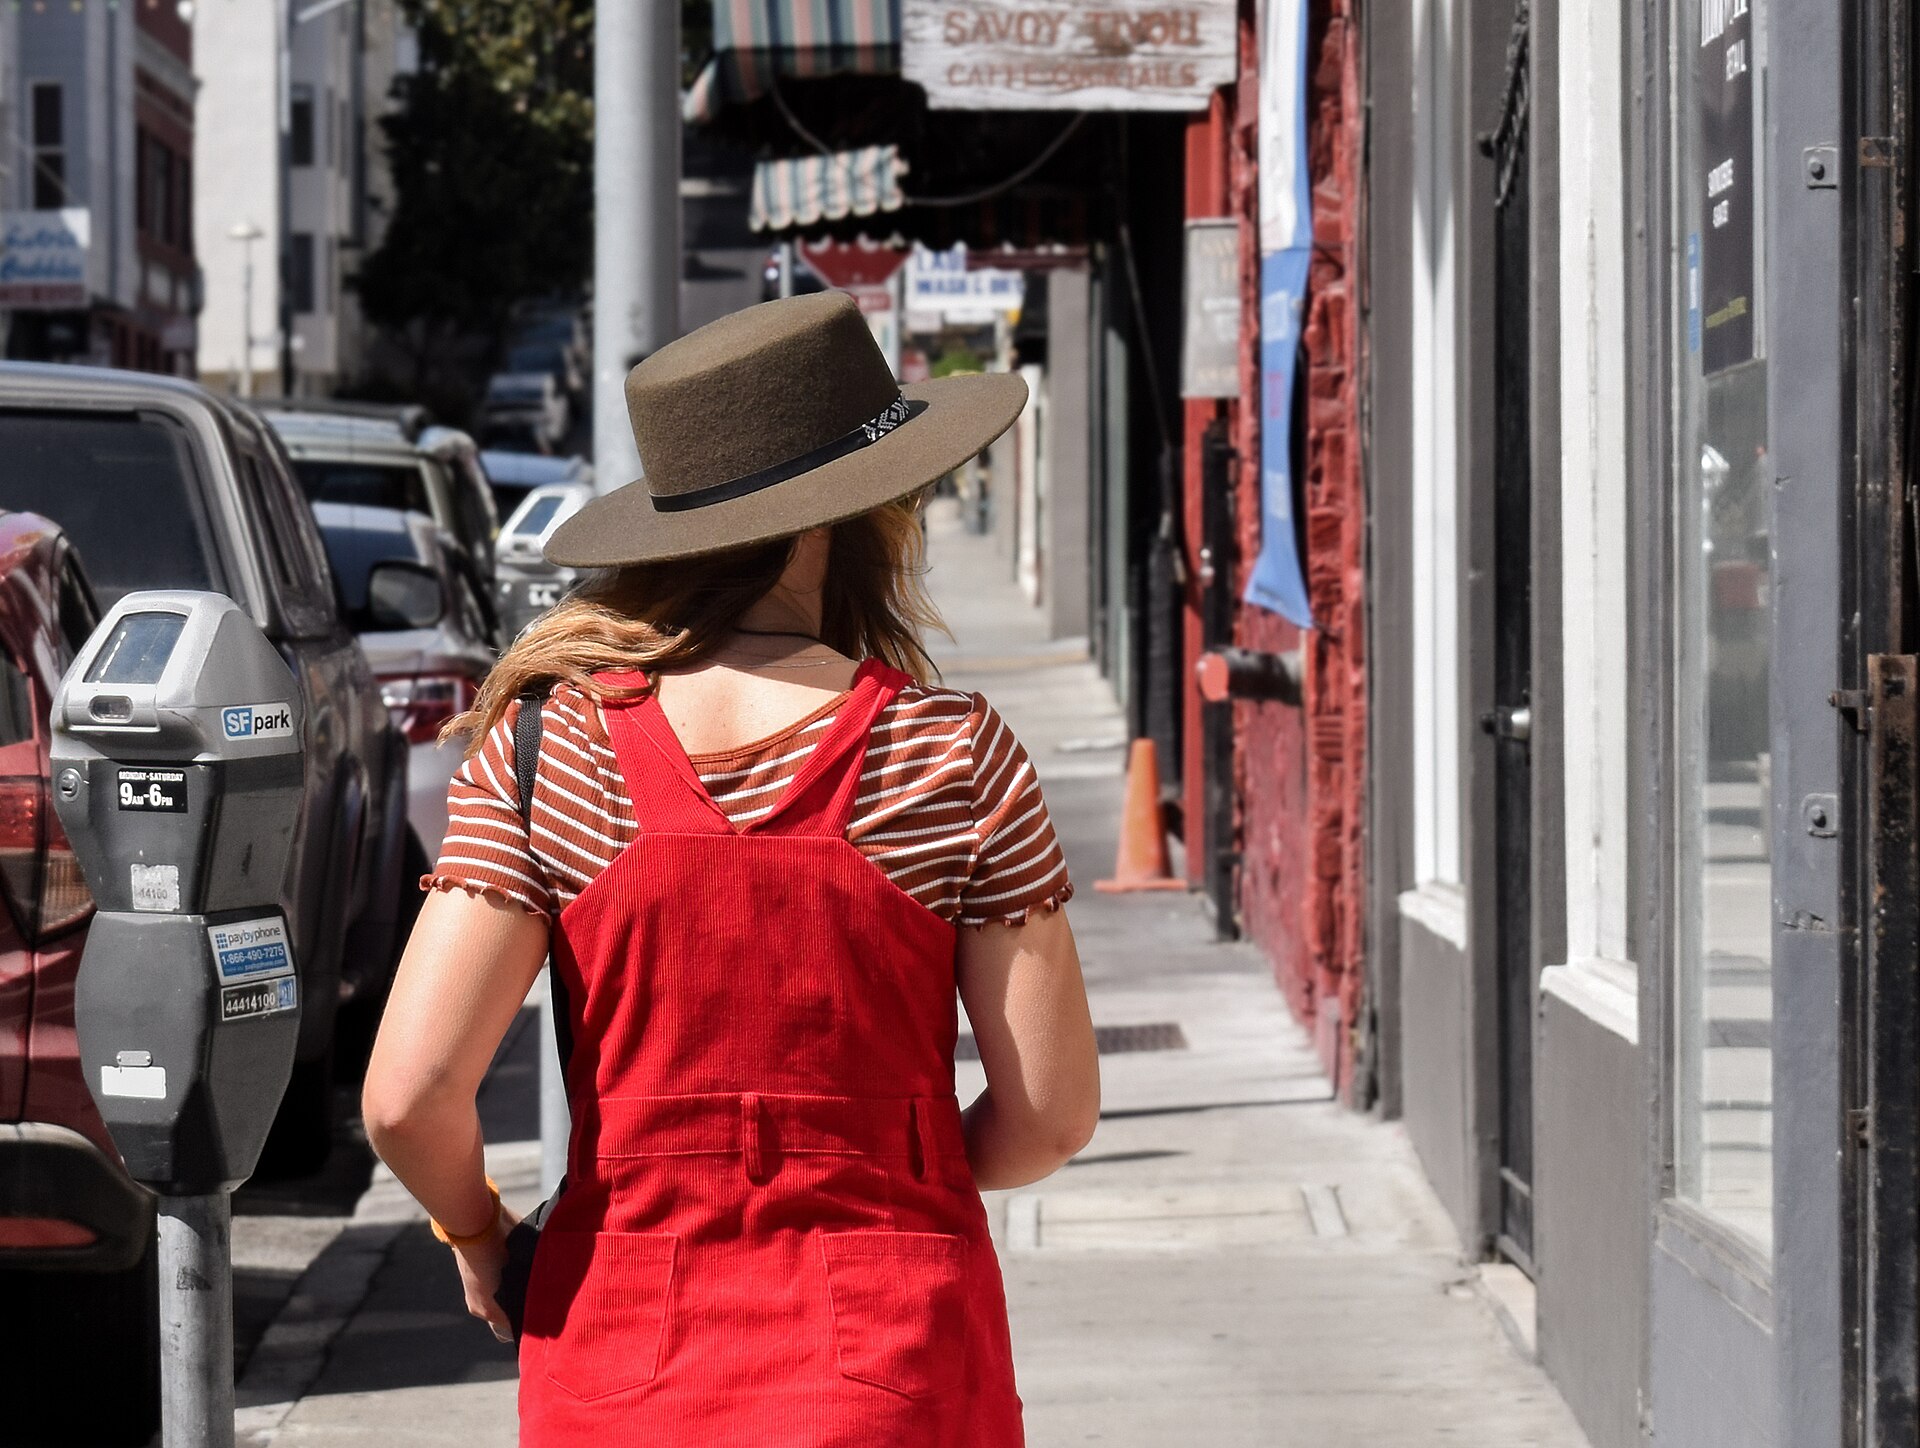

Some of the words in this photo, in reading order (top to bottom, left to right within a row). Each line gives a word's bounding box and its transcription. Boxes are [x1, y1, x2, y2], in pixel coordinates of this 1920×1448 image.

[942, 10, 1068, 47] SAVOY
[1086, 10, 1200, 47] TIVOLI
[1052, 63, 1198, 88] COCKTAILS
[228, 926, 281, 946] paybyphone
[225, 992, 276, 1013] 44414100
